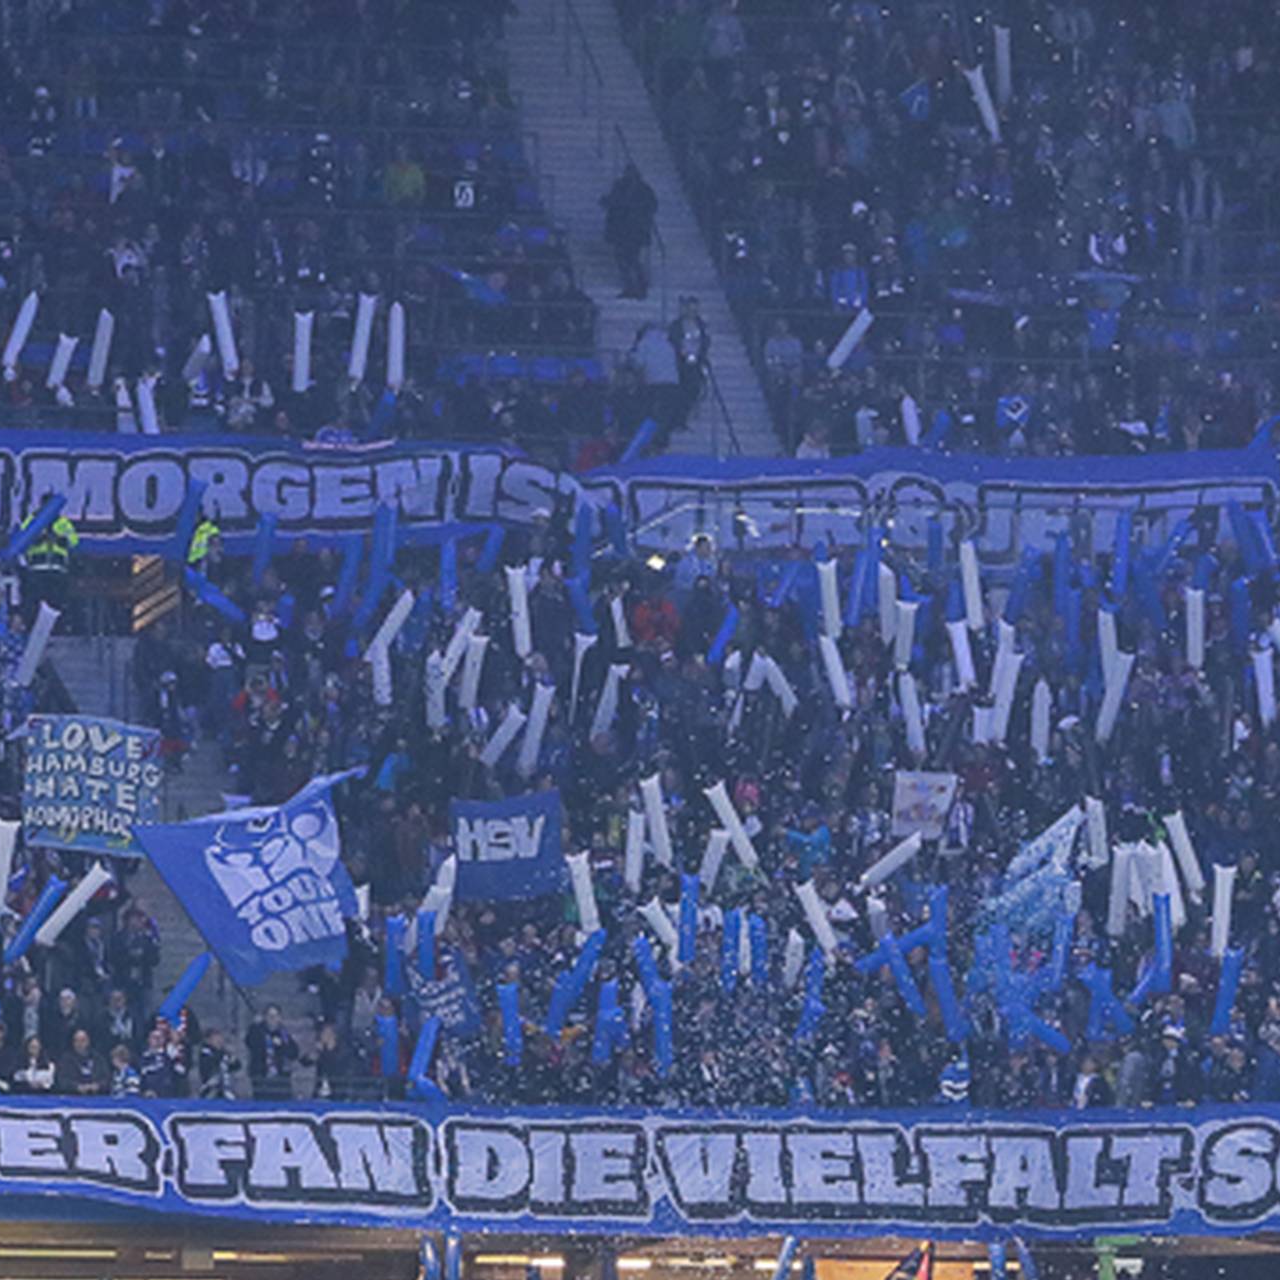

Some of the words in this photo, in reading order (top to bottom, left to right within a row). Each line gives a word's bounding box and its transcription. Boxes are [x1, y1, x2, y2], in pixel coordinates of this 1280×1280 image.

[25, 457, 442, 522] MORGEN
[41, 722, 141, 760] LOVE
[26, 754, 160, 790] HAMBURG
[34, 776, 135, 813] HATE
[456, 813, 546, 861] HSV
[177, 1121, 423, 1193] FAN
[453, 1131, 645, 1201] DIE
[660, 1131, 1182, 1206] VIELFALT
